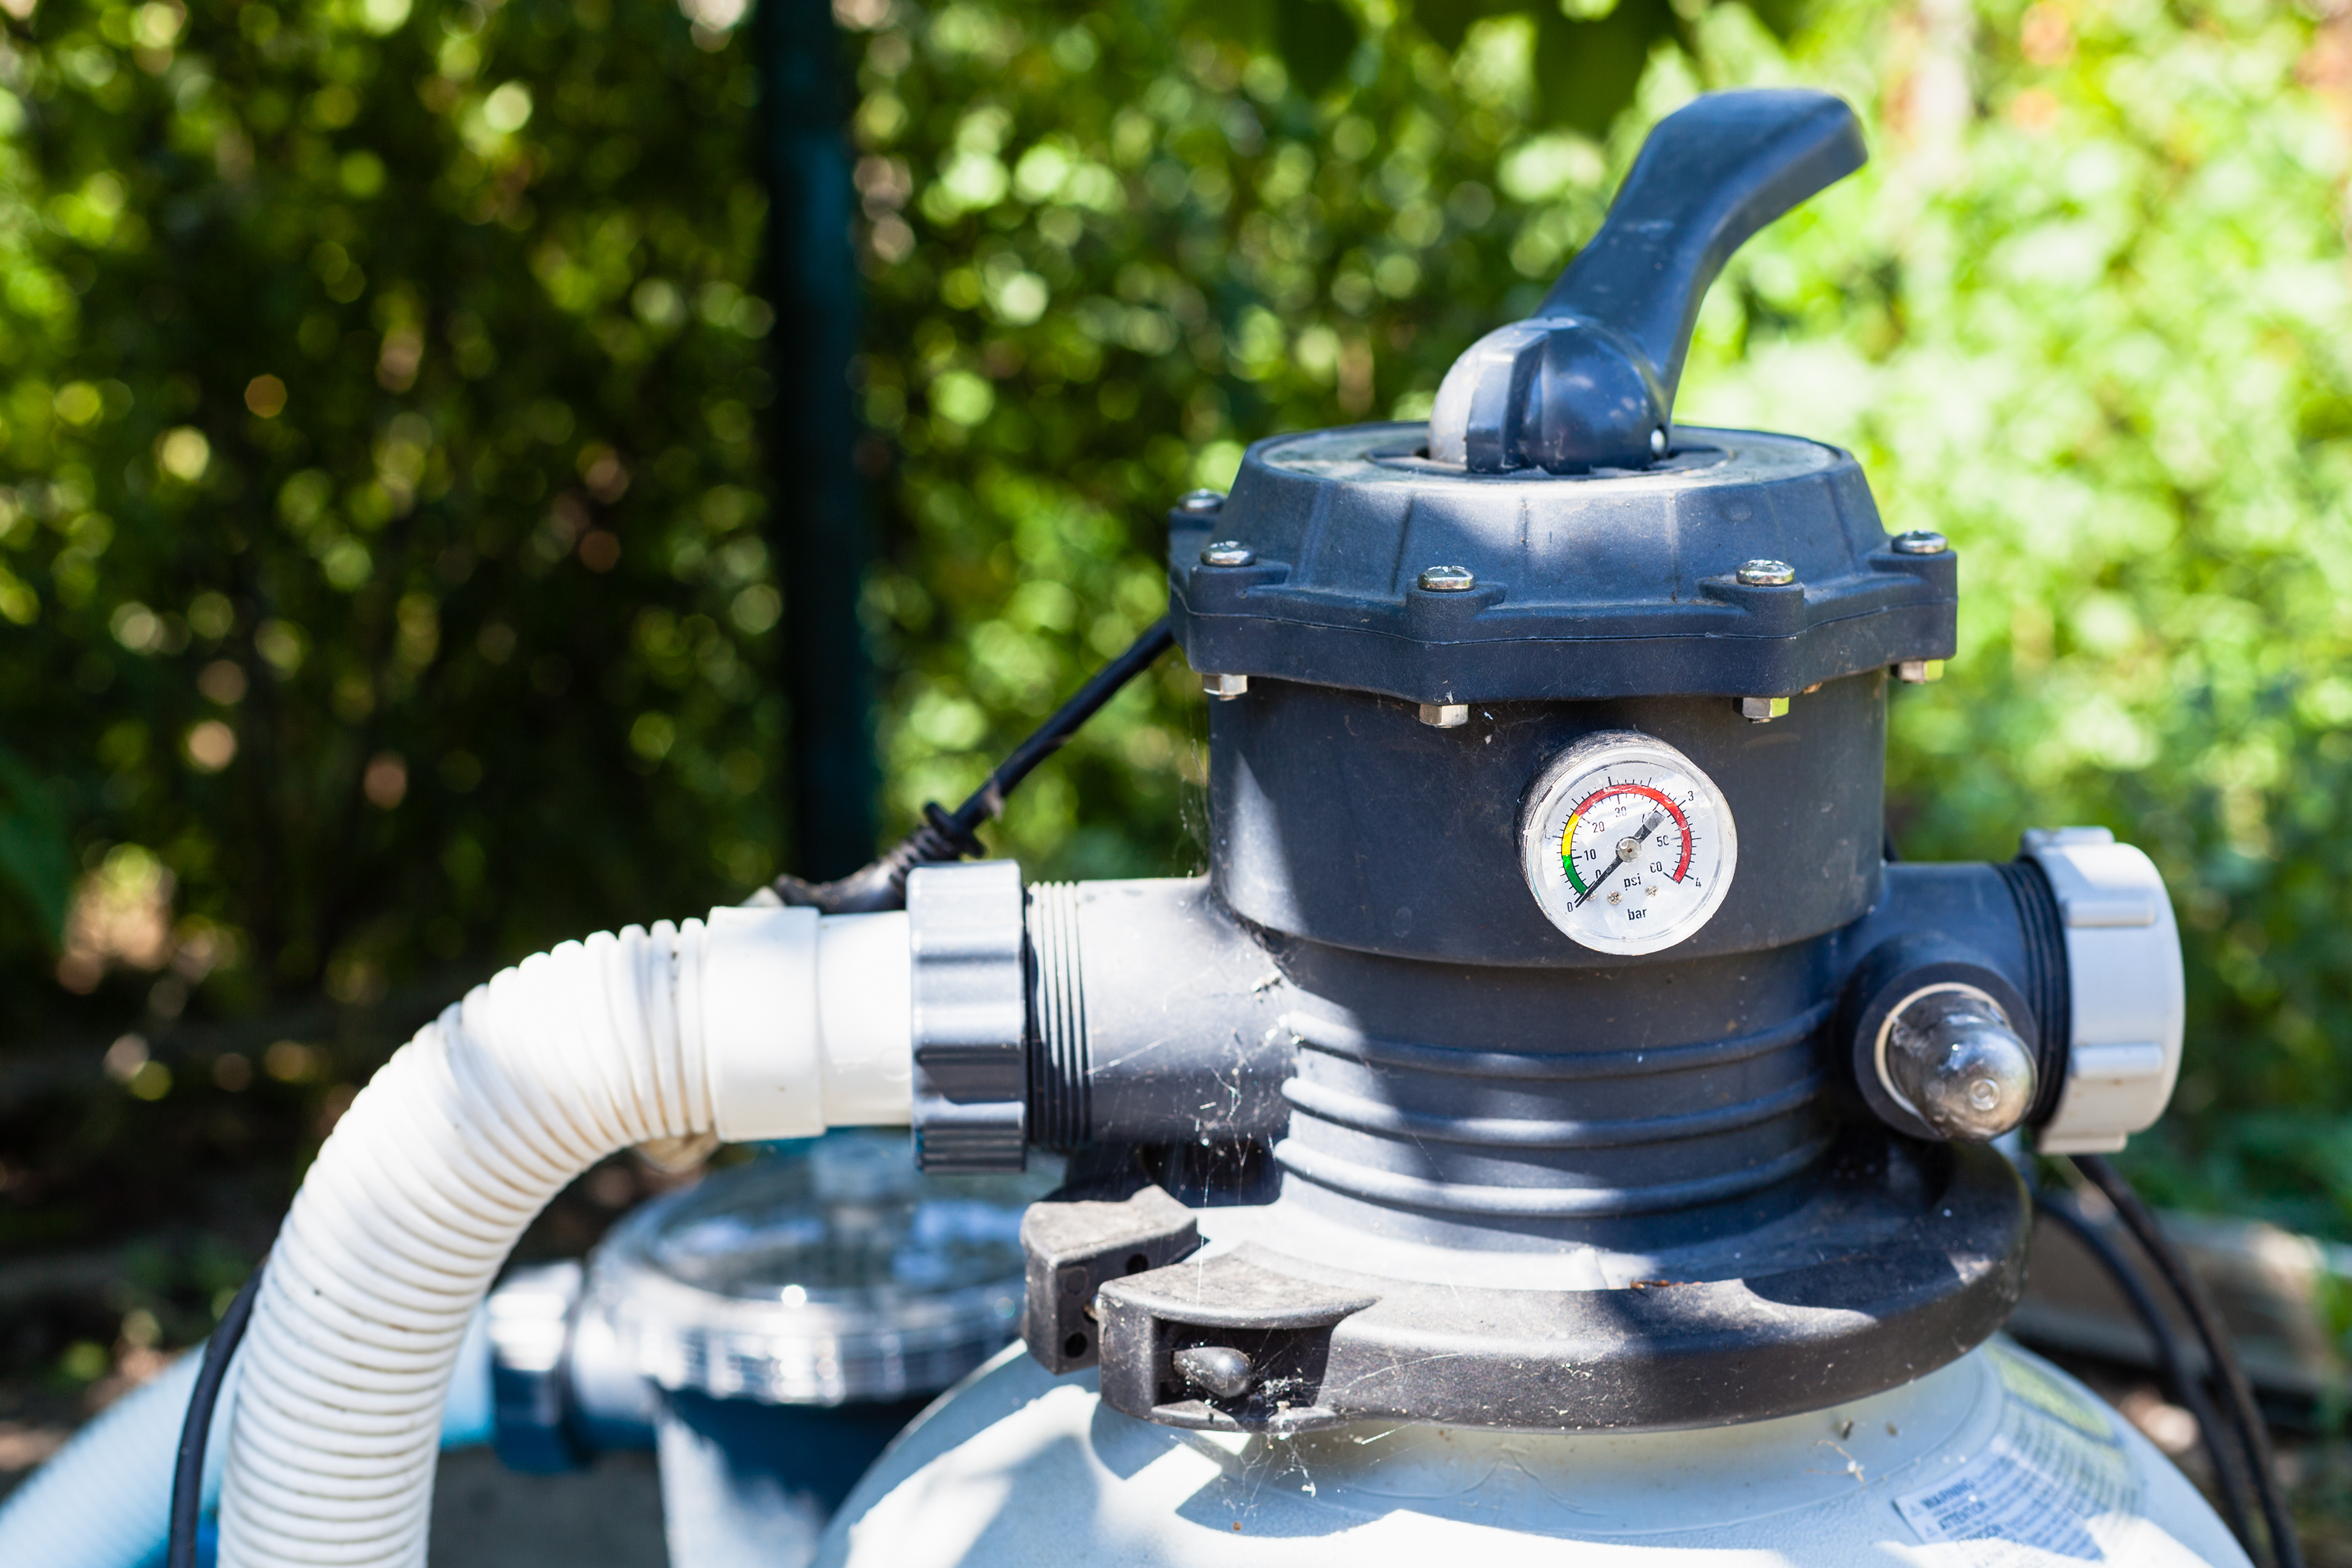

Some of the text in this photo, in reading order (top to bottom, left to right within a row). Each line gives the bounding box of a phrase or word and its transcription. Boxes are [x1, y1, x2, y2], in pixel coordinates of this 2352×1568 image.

[1688, 790, 1693, 801] 3
[1615, 806, 1627, 818] 30
[1592, 821, 1605, 833] 20
[1657, 834, 1670, 847] 50
[1584, 849, 1597, 861] 10
[1624, 873, 1641, 891] psi
[1695, 877, 1702, 888] 4
[1567, 902, 1573, 913] 0
[1627, 908, 1647, 921] bar
